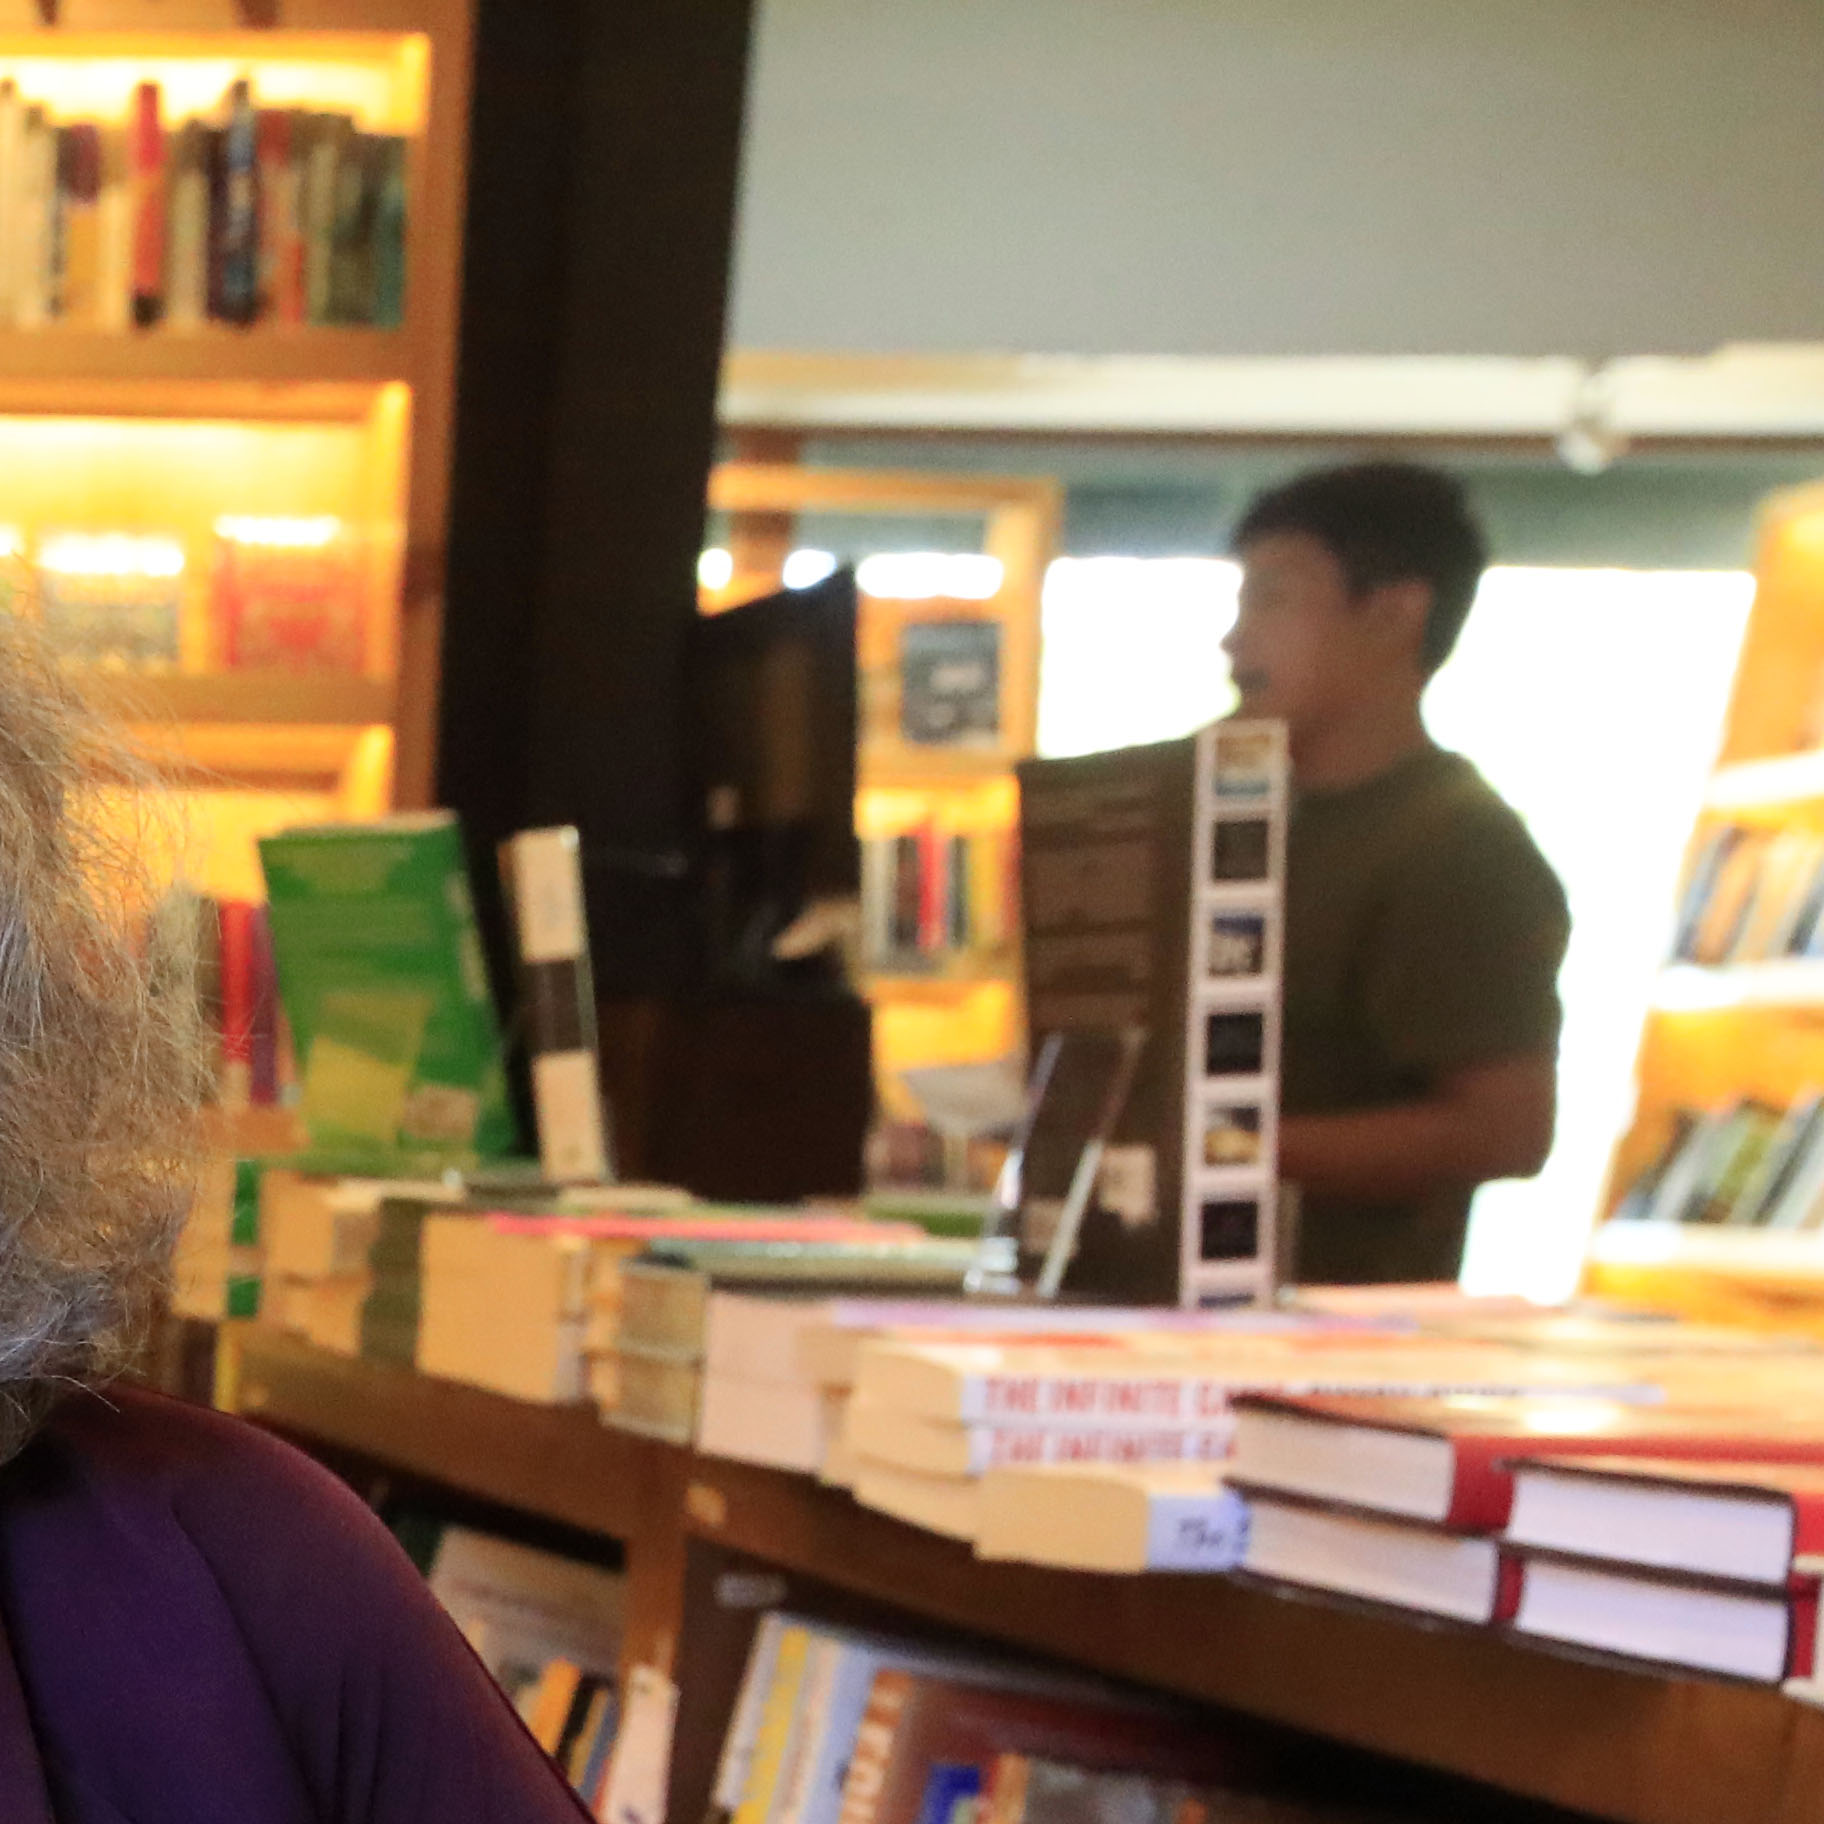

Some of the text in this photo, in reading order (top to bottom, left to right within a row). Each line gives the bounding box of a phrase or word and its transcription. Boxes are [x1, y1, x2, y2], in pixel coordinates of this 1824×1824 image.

[986, 1379, 1039, 1414] THE
[1051, 1379, 1182, 1414] INFINITE
[992, 1431, 1044, 1462] THE
[1056, 1431, 1184, 1460] INFINITE
